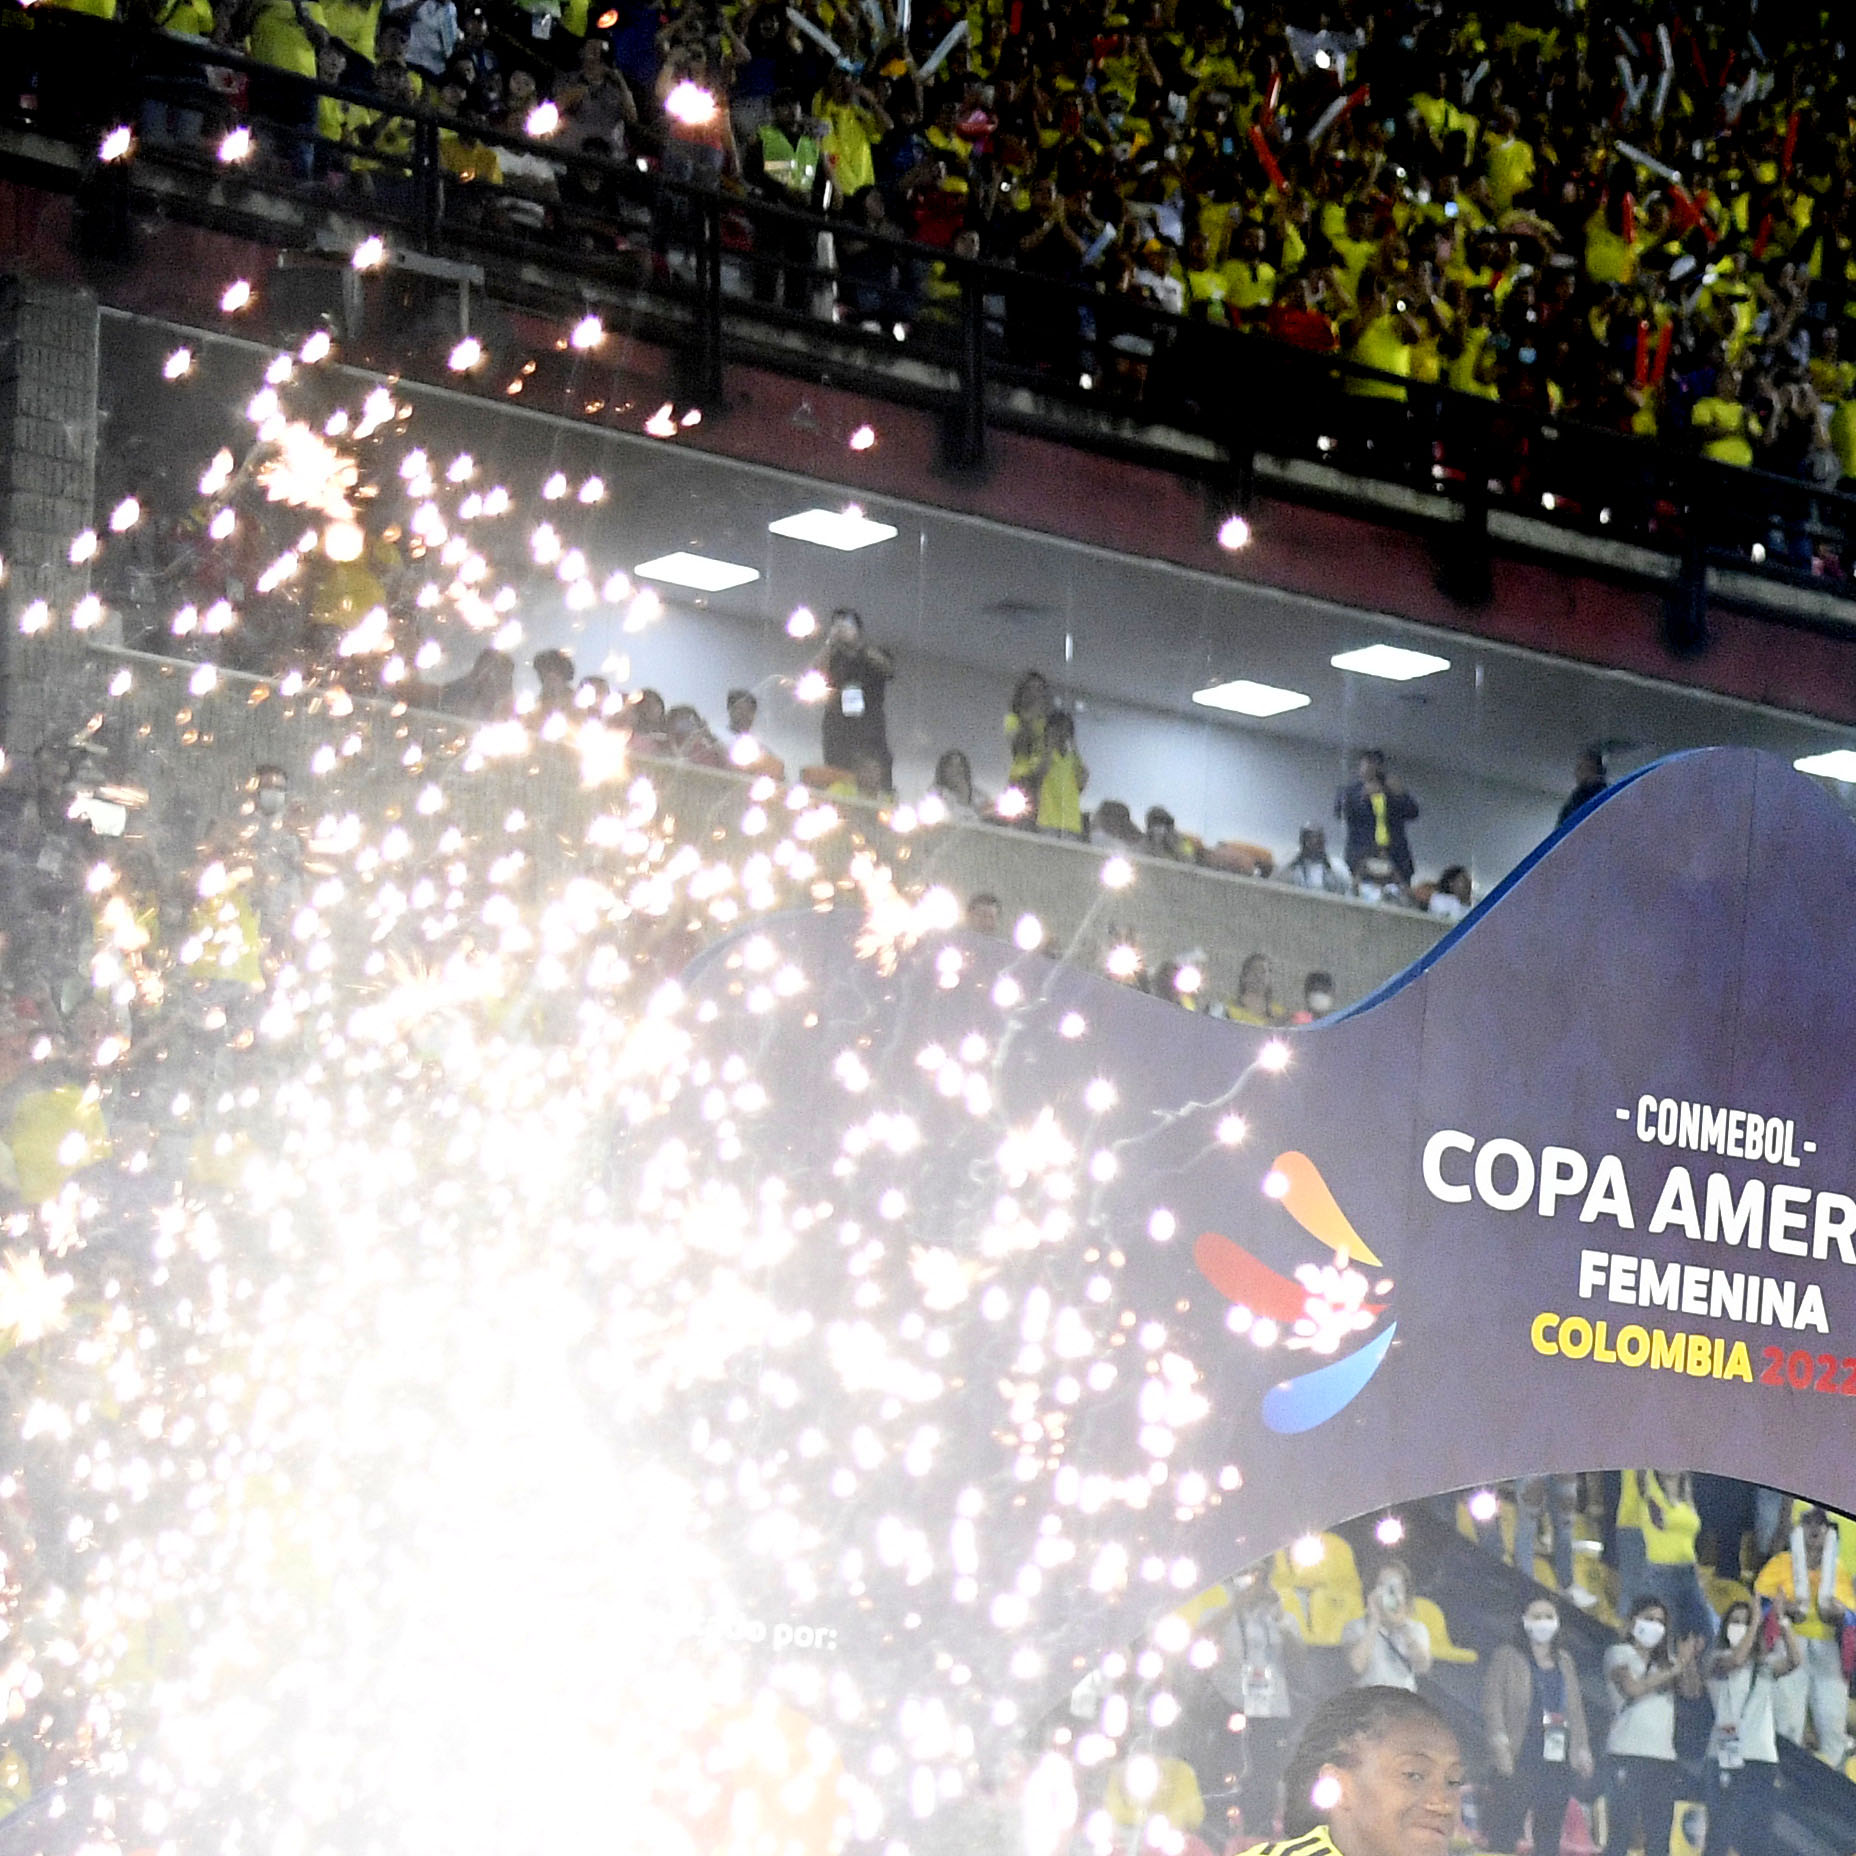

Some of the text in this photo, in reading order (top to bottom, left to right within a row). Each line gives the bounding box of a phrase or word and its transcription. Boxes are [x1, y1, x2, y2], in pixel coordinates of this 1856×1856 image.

[1422, 1129, 1635, 1229] COPA
[1578, 1249, 1830, 1334] FEMENINA
[1530, 1312, 1753, 1383] COLOMBIA
